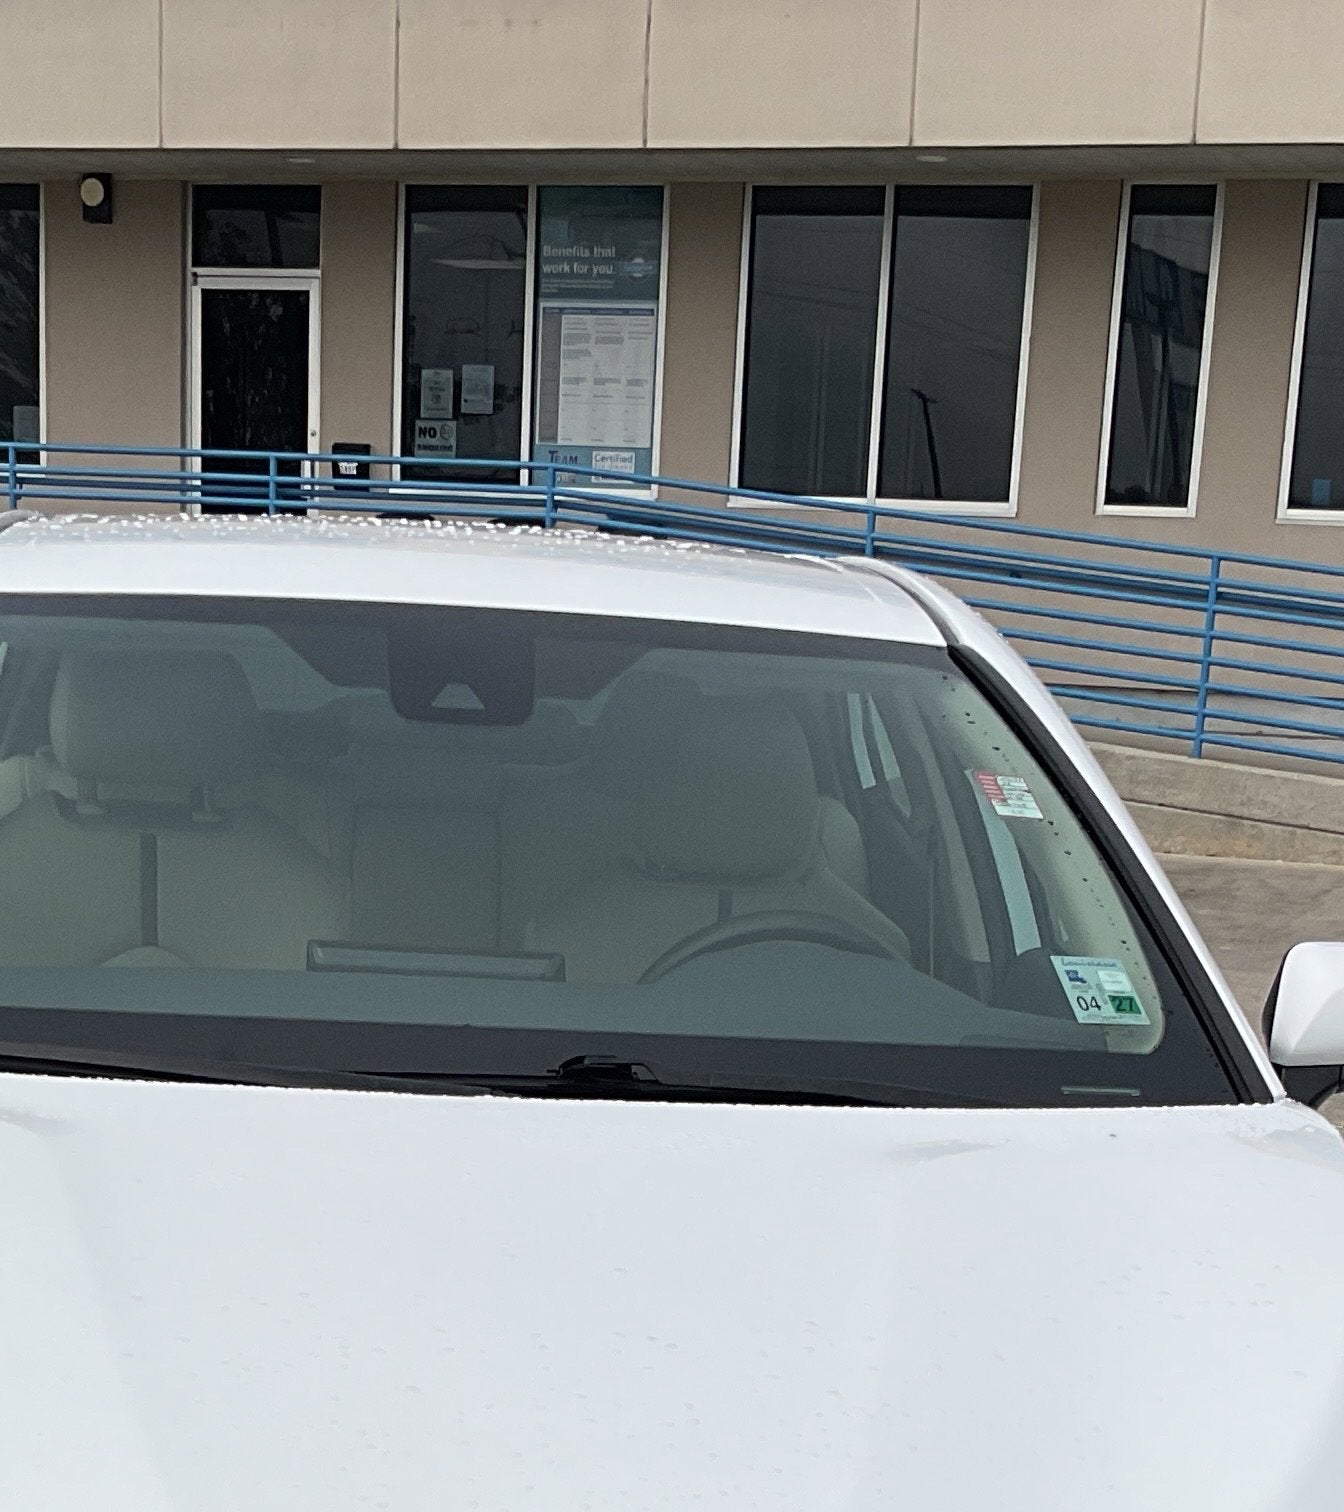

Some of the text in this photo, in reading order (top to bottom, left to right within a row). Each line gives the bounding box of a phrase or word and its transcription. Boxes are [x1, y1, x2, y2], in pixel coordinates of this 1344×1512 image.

[543, 245, 616, 258] Benefits that
[542, 262, 571, 274] work
[573, 262, 589, 274] for
[418, 426, 437, 439] NO
[548, 450, 578, 465] TEAM
[594, 453, 633, 463] Certified
[1076, 996, 1135, 1012] 04 27
